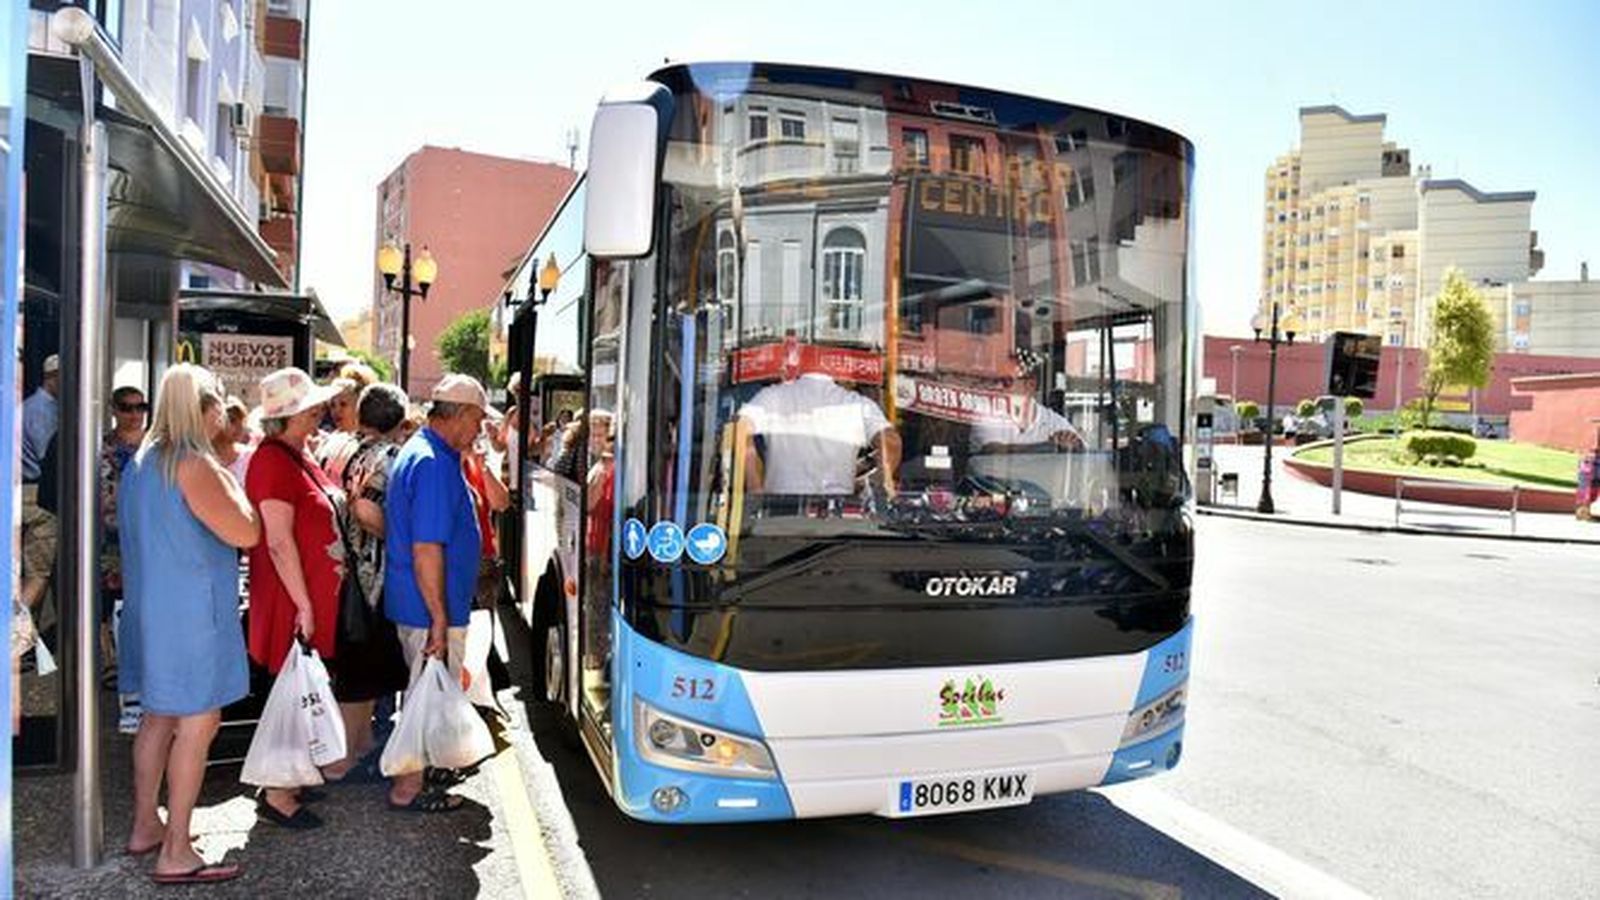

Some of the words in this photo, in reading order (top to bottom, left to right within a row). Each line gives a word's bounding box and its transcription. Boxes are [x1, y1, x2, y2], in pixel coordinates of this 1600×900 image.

[920, 180, 1055, 222] CENTRO
[209, 341, 287, 356] NUEVOS
[208, 354, 287, 369] McSHAKE
[926, 575, 1018, 596] OTOKAR
[671, 675, 715, 701] 512
[915, 779, 976, 807] 8068
[983, 774, 1028, 801] KMX
